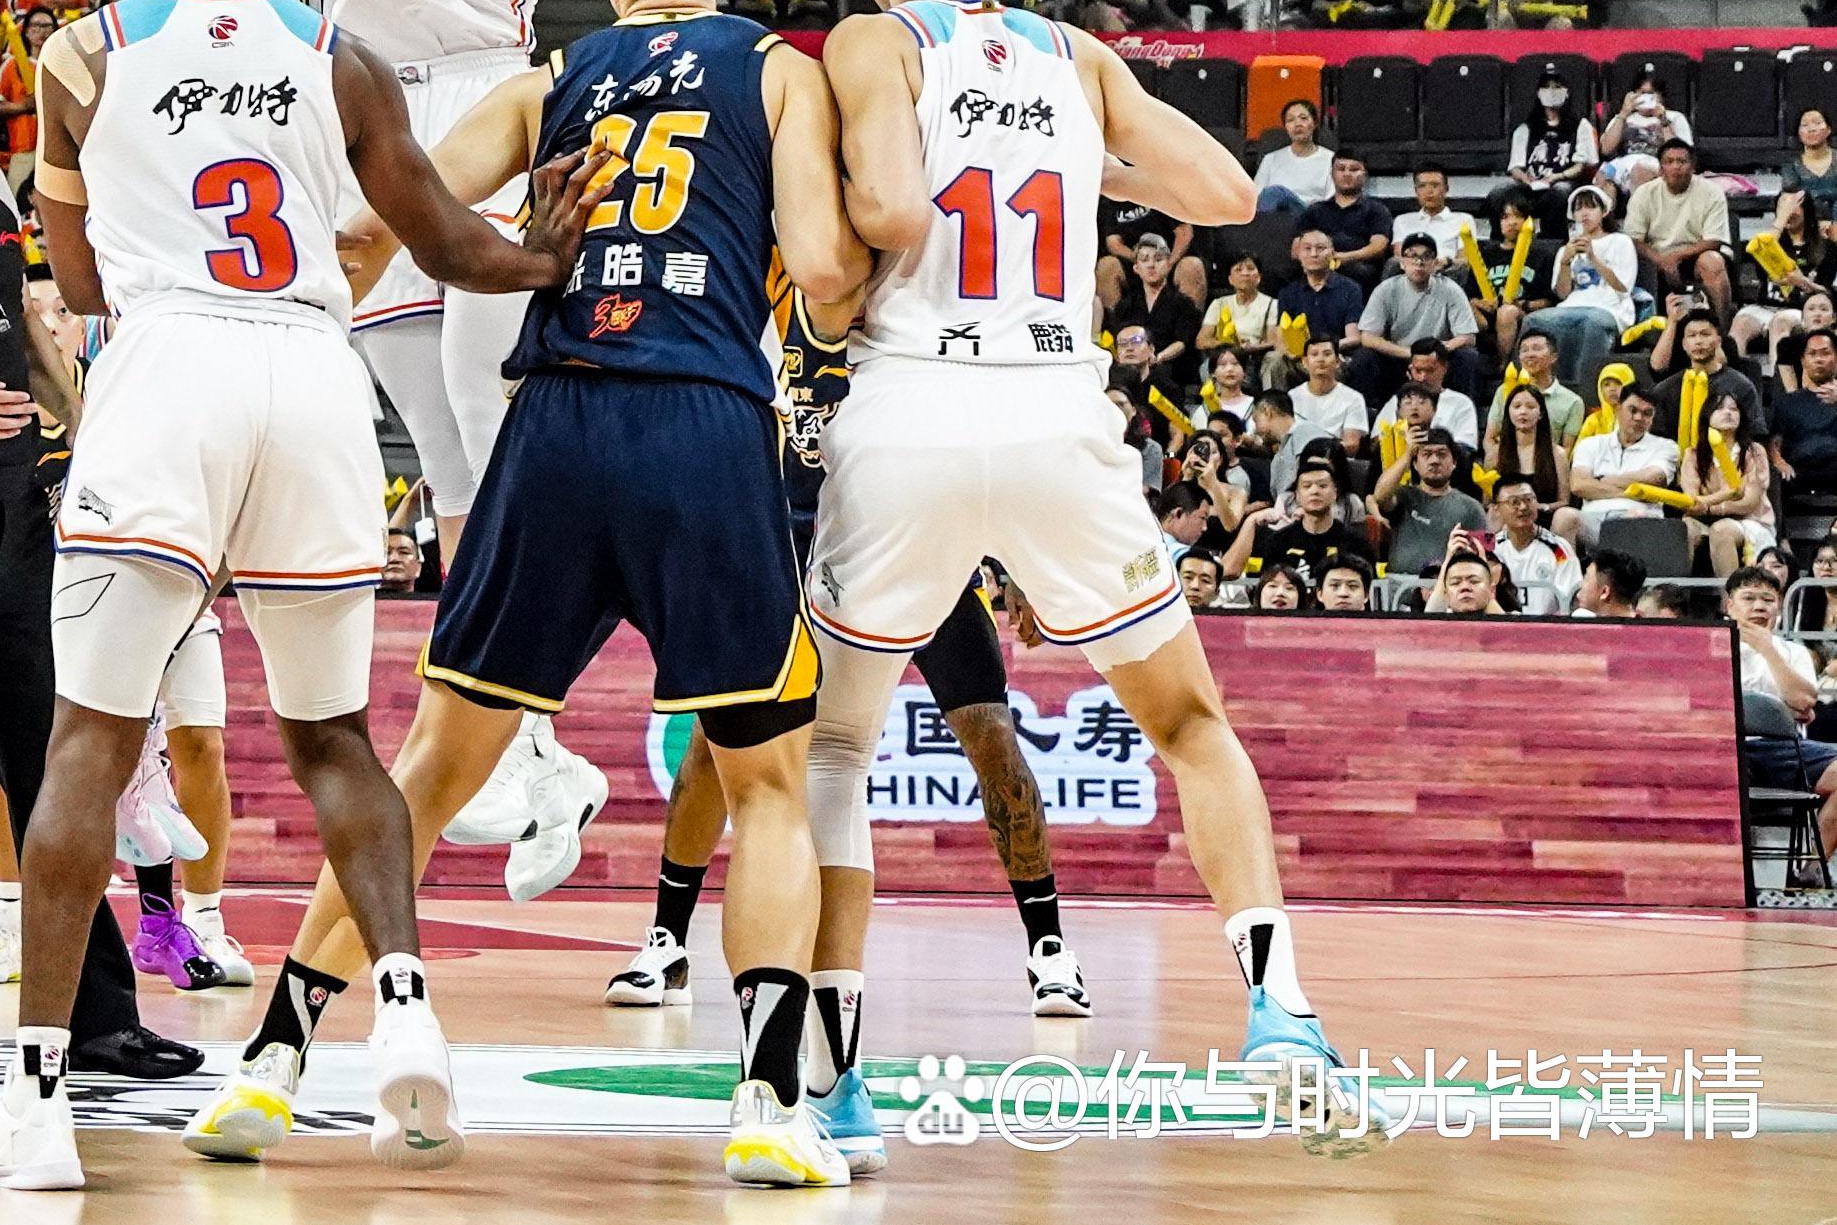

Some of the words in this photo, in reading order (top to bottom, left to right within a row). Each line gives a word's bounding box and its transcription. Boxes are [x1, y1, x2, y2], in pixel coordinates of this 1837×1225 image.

[192, 157, 299, 293] 3
[581, 110, 711, 236] 25
[931, 166, 1064, 303] 11
[866, 775, 981, 807] HIN
[1043, 777, 1141, 809] IFE
[877, 700, 1143, 764] 国人寿
